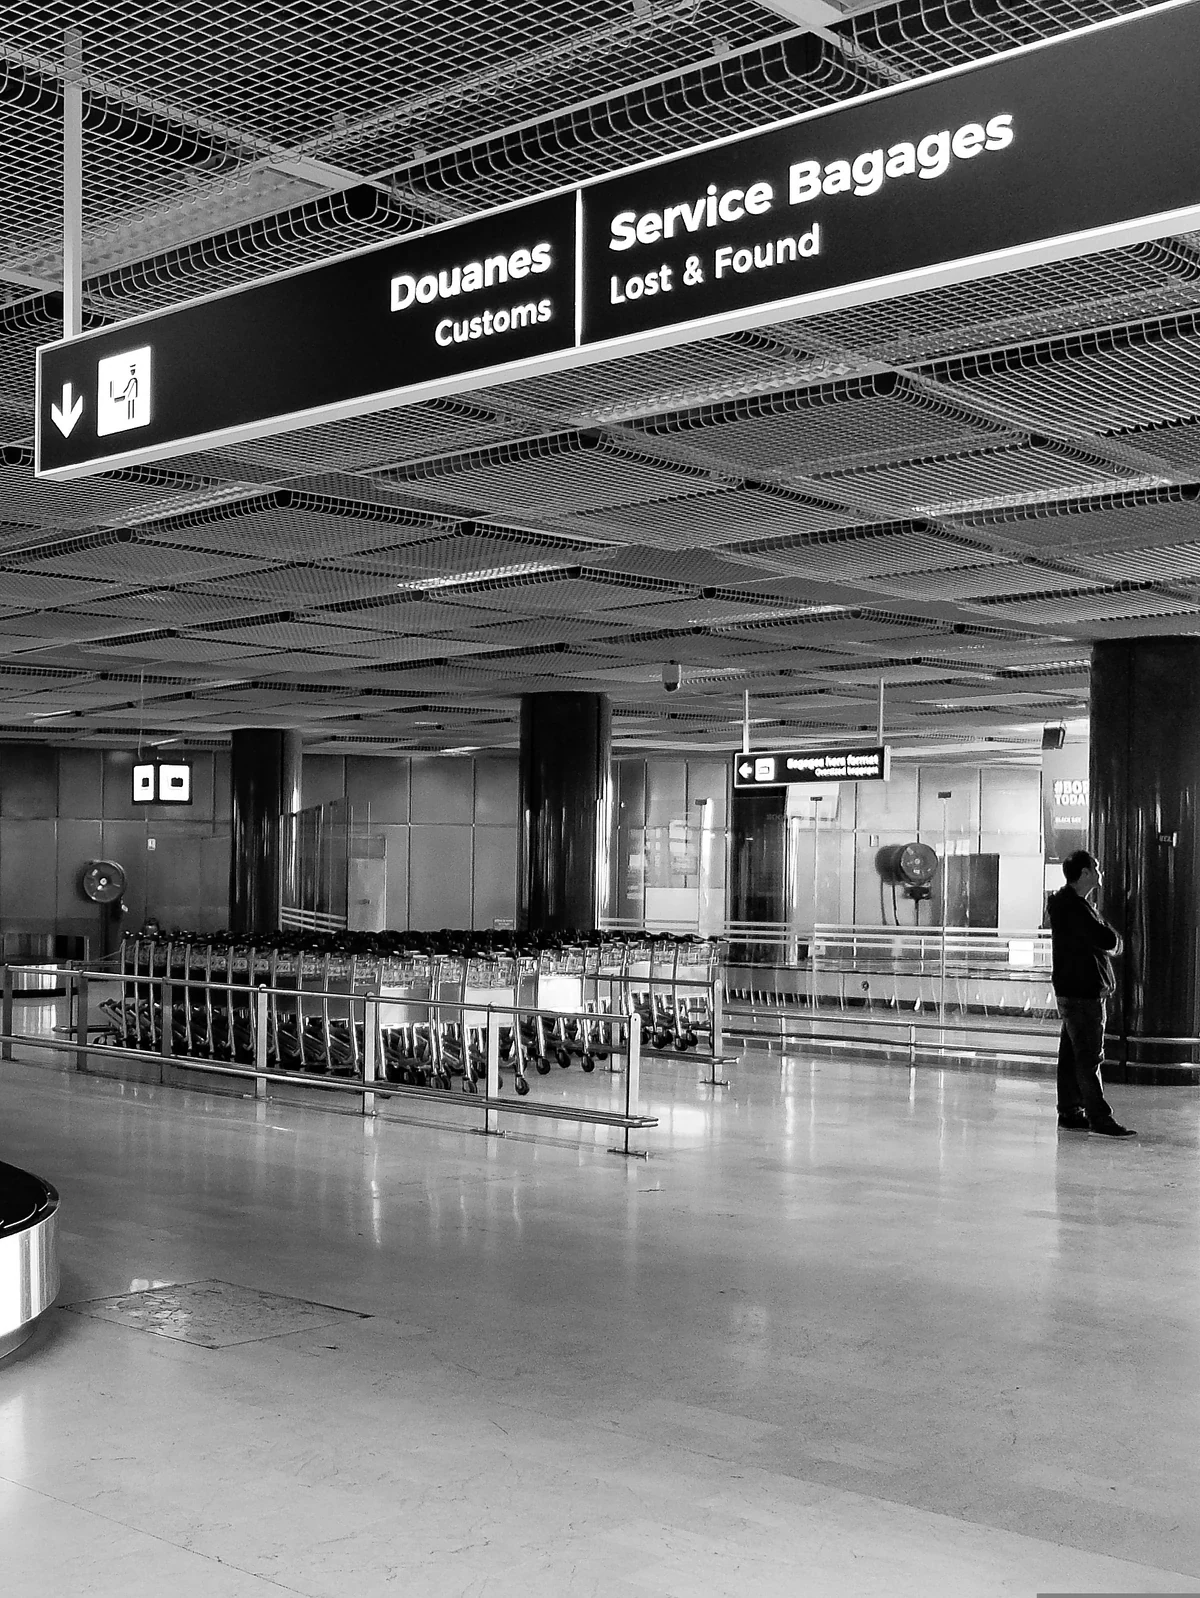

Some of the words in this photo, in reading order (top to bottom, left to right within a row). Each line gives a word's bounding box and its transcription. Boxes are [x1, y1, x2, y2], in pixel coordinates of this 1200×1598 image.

[608, 181, 775, 252] Service
[788, 113, 1015, 206] Bagages
[389, 241, 553, 312] Douanes
[610, 264, 673, 305] Lost
[682, 255, 705, 286] &
[714, 222, 821, 280] Found
[433, 299, 553, 348] Customs
